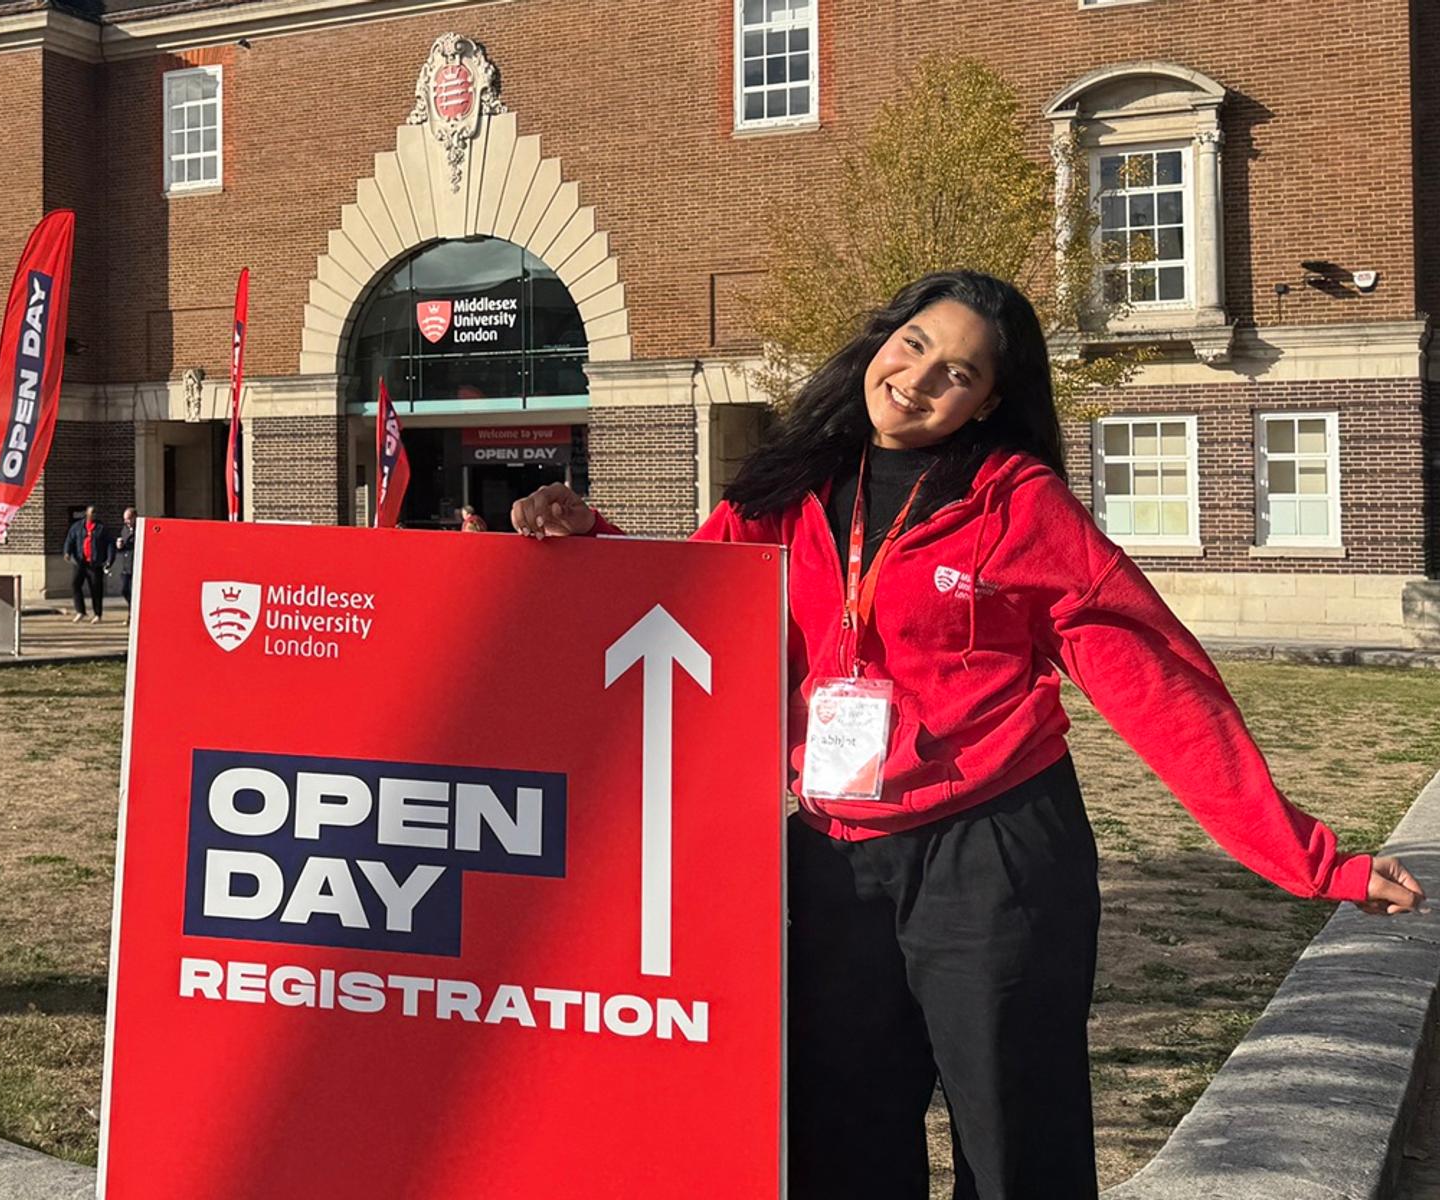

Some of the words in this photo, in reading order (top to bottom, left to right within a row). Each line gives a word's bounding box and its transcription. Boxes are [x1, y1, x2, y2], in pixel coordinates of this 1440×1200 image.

[453, 297, 517, 312] Middlesex
[453, 311, 517, 328] University
[453, 328, 498, 343] London
[2, 370, 39, 479] OPEN
[21, 276, 48, 358] DAY
[478, 429, 519, 439] Welcome
[521, 429, 531, 439] to
[532, 430, 553, 441] your
[474, 449, 518, 460] OPEN
[523, 448, 557, 459] DAY
[266, 584, 375, 610] Middlesex
[265, 609, 372, 640] University
[264, 635, 339, 658] London
[207, 767, 543, 857] OPEN
[203, 848, 448, 933] DAY
[178, 957, 709, 1043] REGISTRATION
